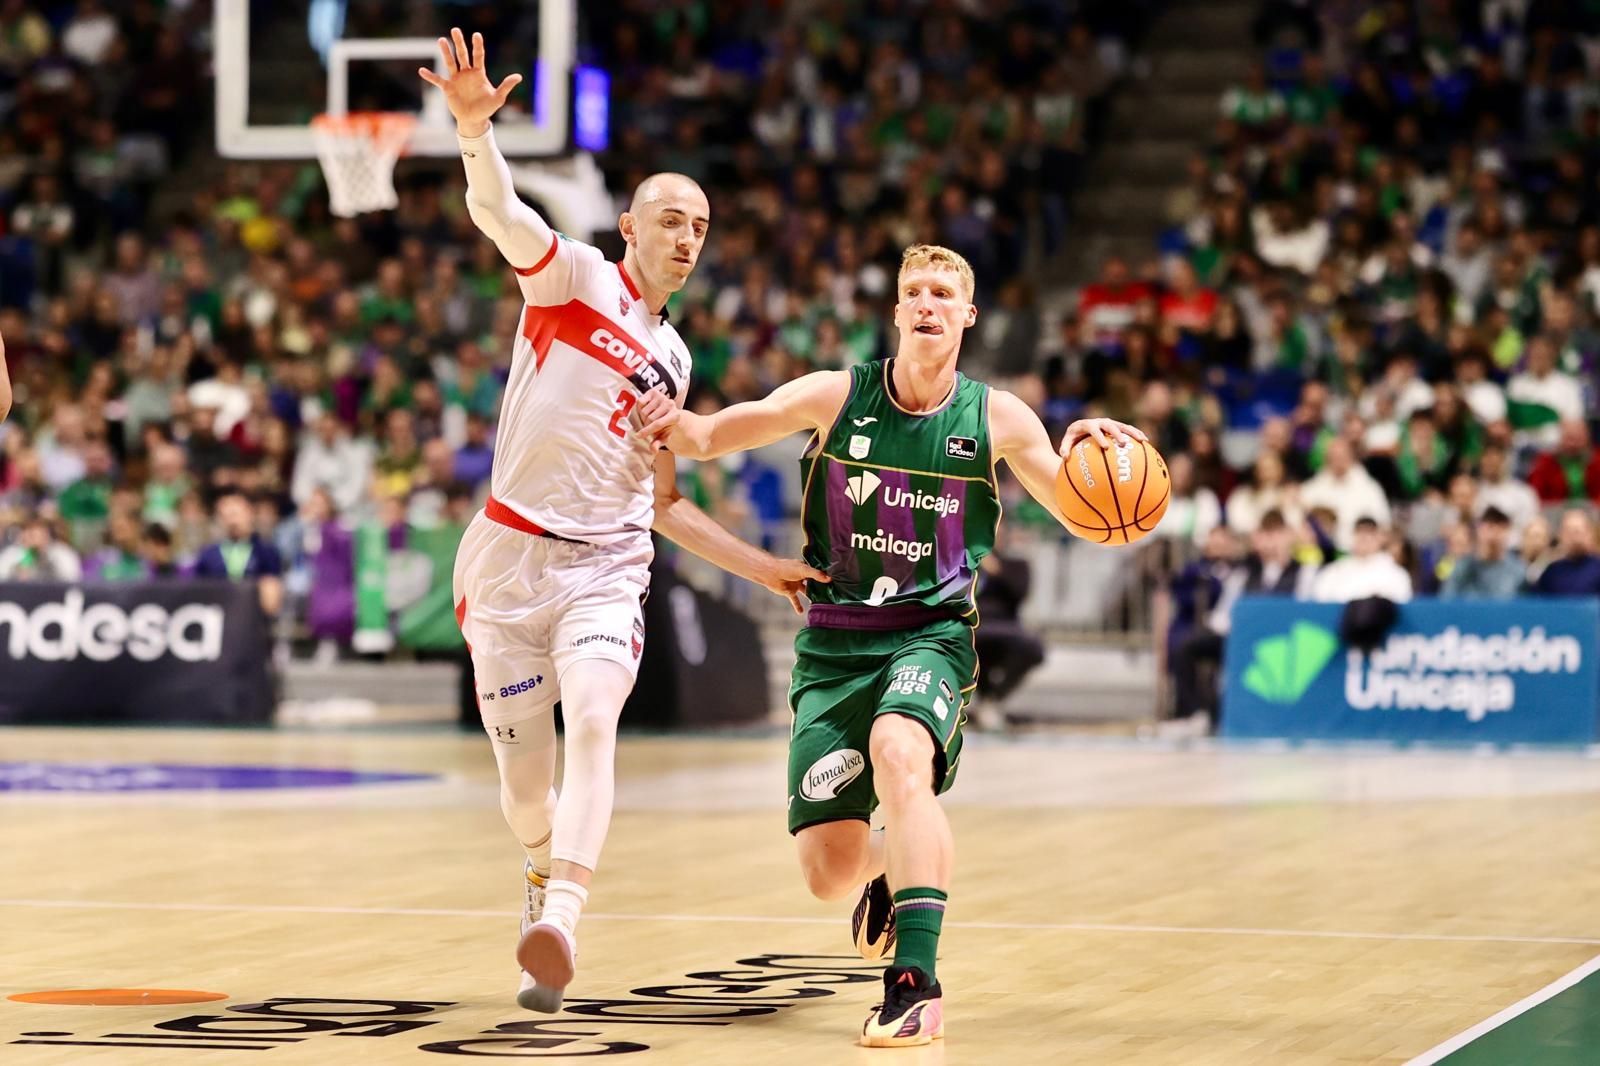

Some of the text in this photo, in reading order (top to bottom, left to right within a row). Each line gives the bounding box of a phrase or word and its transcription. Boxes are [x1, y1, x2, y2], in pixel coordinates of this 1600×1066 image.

[608, 389, 637, 439] 2
[884, 486, 960, 518] Unicaja
[576, 634, 627, 648] BERNER
[1345, 664, 1515, 722] Unicaja
